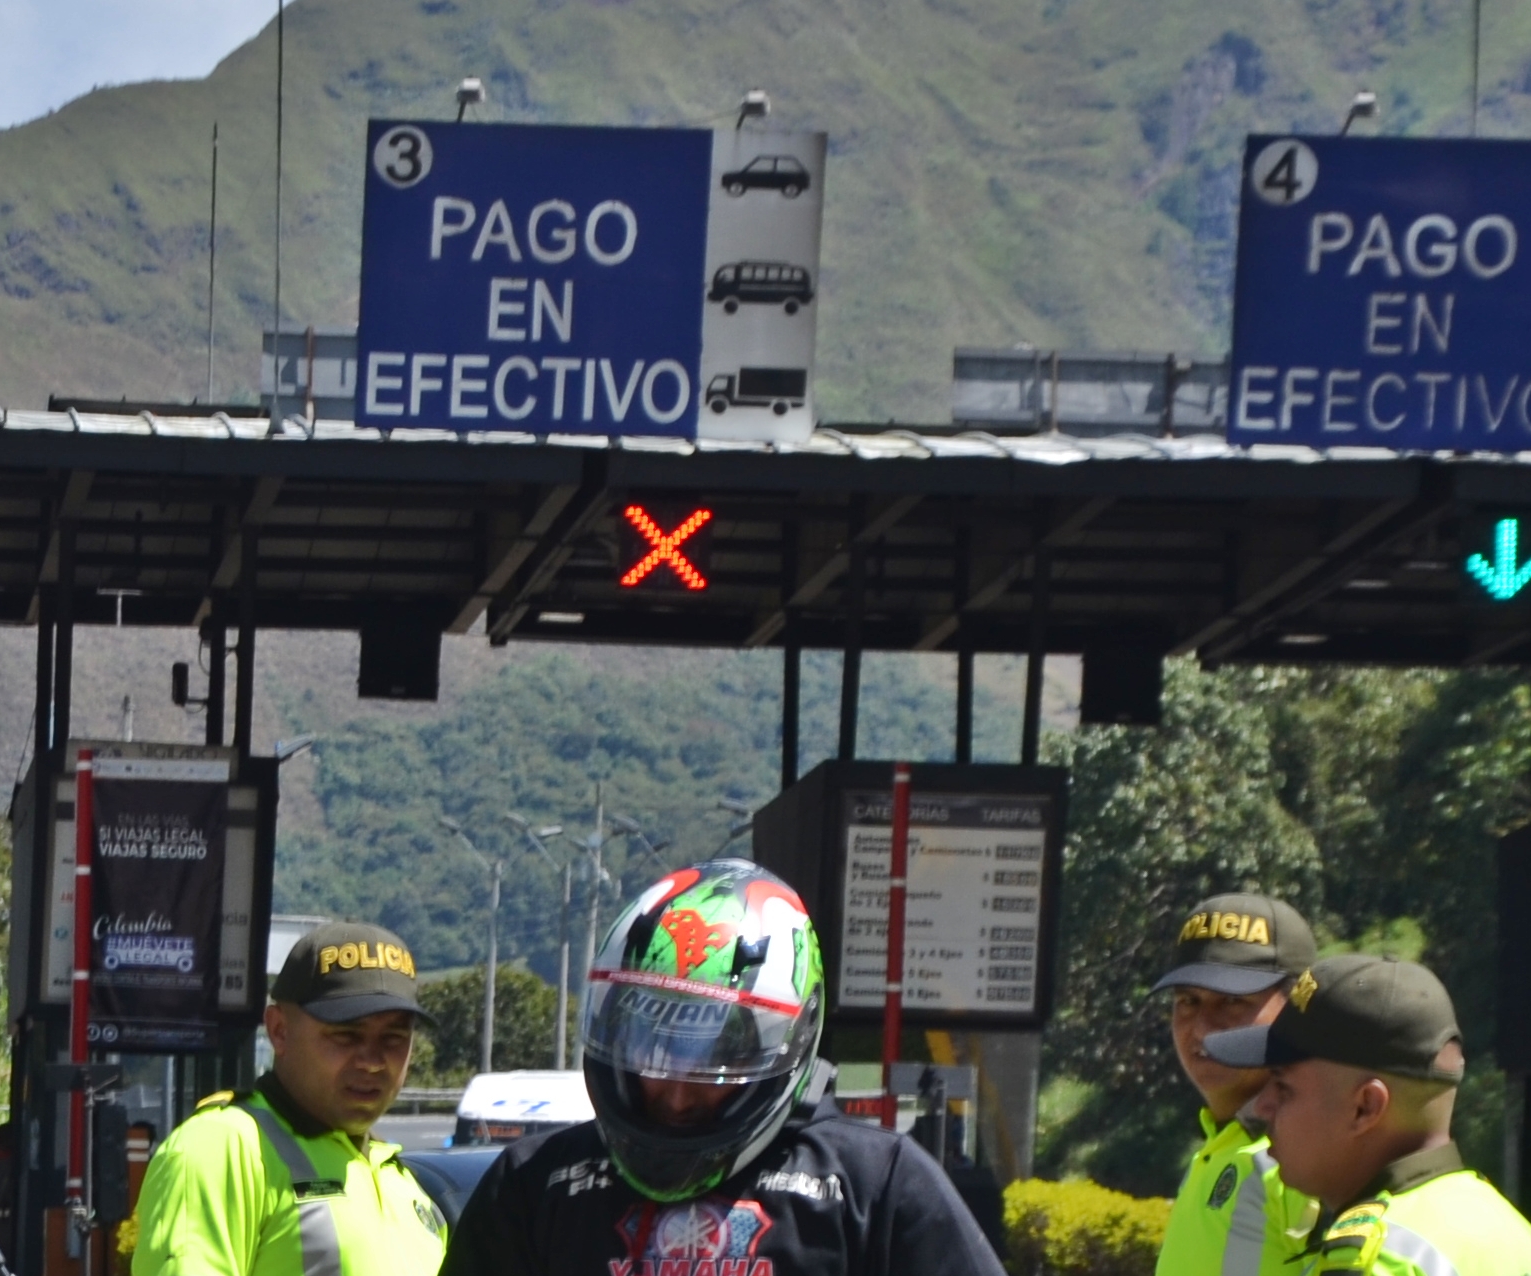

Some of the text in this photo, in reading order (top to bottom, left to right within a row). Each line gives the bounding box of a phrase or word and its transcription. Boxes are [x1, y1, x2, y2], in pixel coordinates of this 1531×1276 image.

[385, 131, 422, 182] 3
[1262, 147, 1302, 200] 4
[430, 197, 638, 265] PAGO
[1307, 213, 1518, 278] PAGO
[488, 278, 573, 342] EN
[1366, 293, 1454, 355] EN
[365, 352, 691, 422] EFECTIVO
[1235, 367, 1531, 433] EFECTIV
[99, 825, 111, 841] SI
[115, 827, 161, 843] VIAJAS
[99, 843, 207, 860] VIAJAS SEGURO
[93, 909, 173, 940] Colombia
[126, 950, 170, 964] LEGAL
[320, 941, 416, 979] POLICIA
[618, 986, 731, 1034] NOLAN
